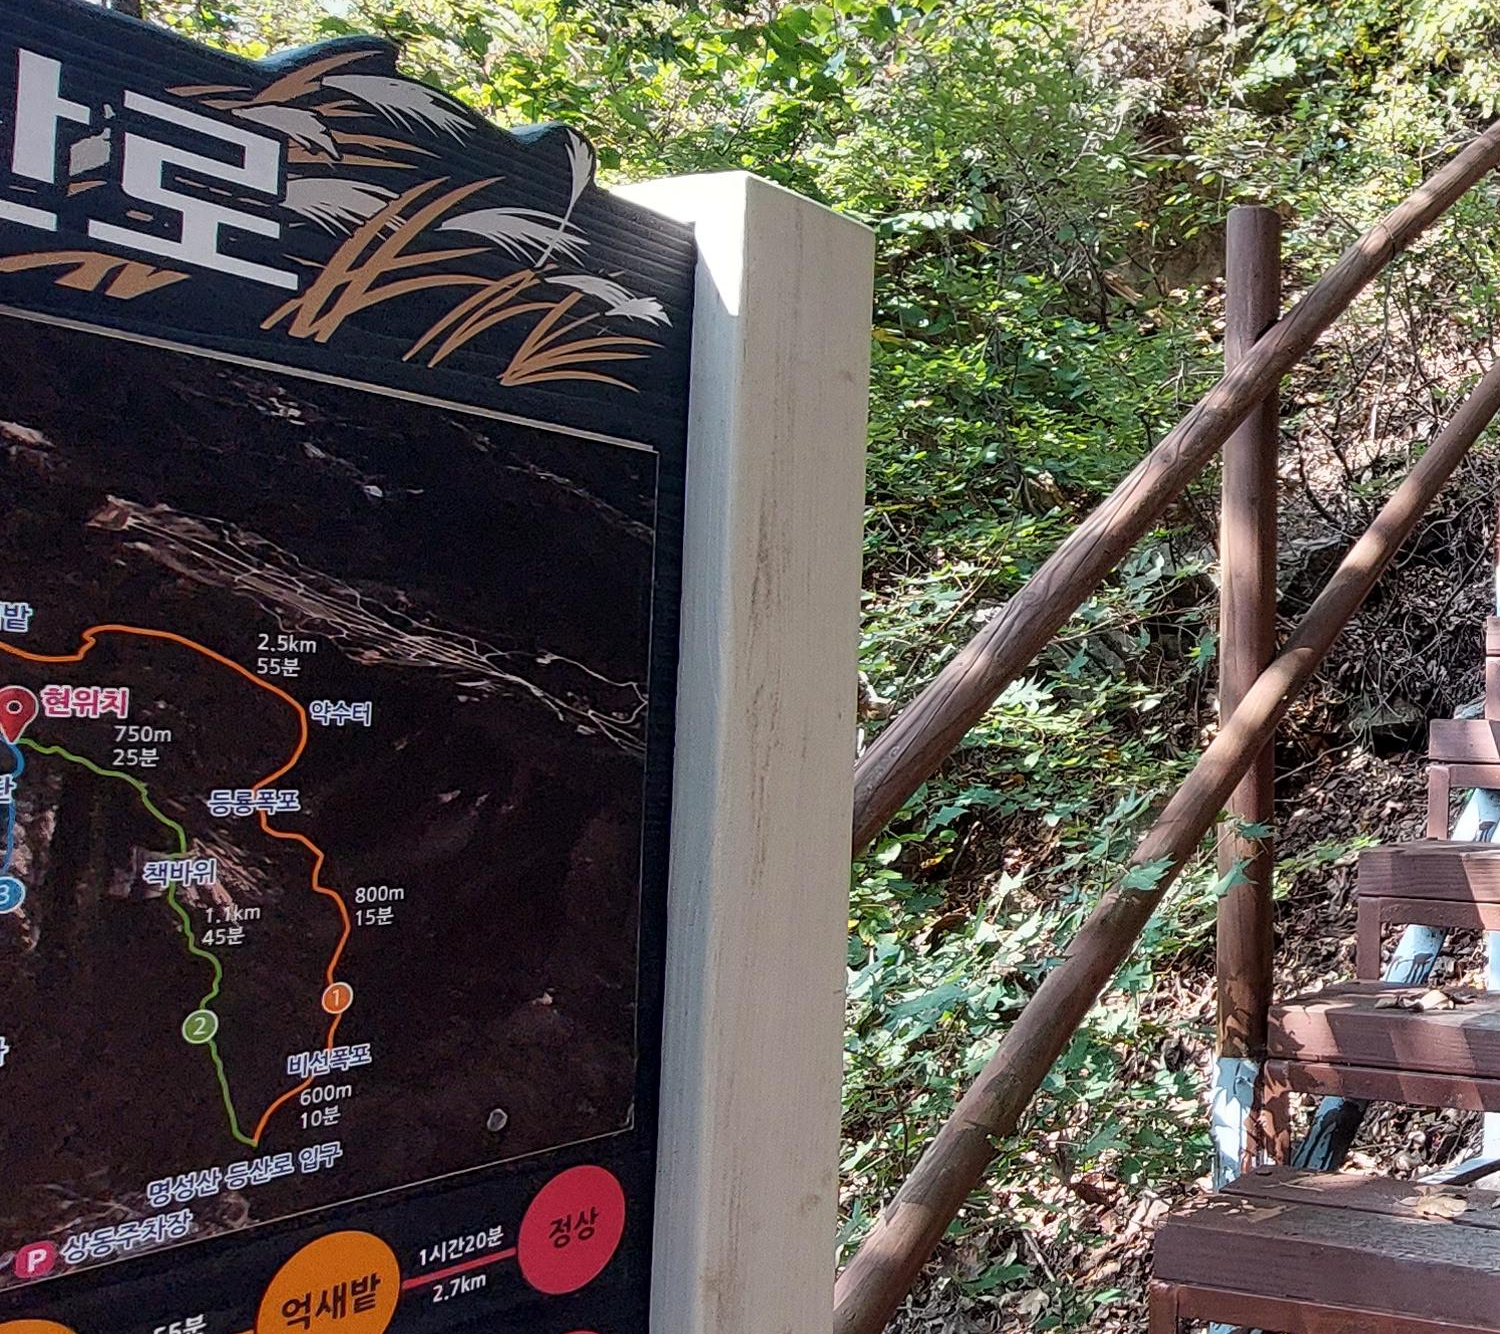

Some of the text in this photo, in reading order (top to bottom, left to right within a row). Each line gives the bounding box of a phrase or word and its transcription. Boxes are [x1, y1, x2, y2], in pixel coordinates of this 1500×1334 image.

[257, 633, 317, 653] 2.5km
[257, 657, 301, 677] 55분
[39, 685, 130, 718] 현위치
[309, 700, 372, 726] 약수터
[115, 725, 172, 743] 750m
[112, 748, 160, 768] 25분
[207, 789, 301, 816] 등룡폭포
[143, 858, 217, 887] 책바위
[355, 885, 405, 904] 800m
[205, 905, 261, 924] 1.1km
[355, 906, 394, 926] 15분
[201, 925, 245, 946] 45분
[192, 1018, 206, 1036] 2
[287, 1043, 373, 1079] 비선폭포
[300, 1084, 352, 1106] 600m
[300, 1105, 341, 1129] 10분
[147, 1141, 343, 1208] 명성산 등산로 입구
[27, 1208, 194, 1272] P 상동주차장
[548, 1206, 600, 1249] 정상
[419, 1225, 504, 1267] 1시간20분
[432, 1273, 487, 1303] 2.7km
[281, 1272, 382, 1331] 억새밭
